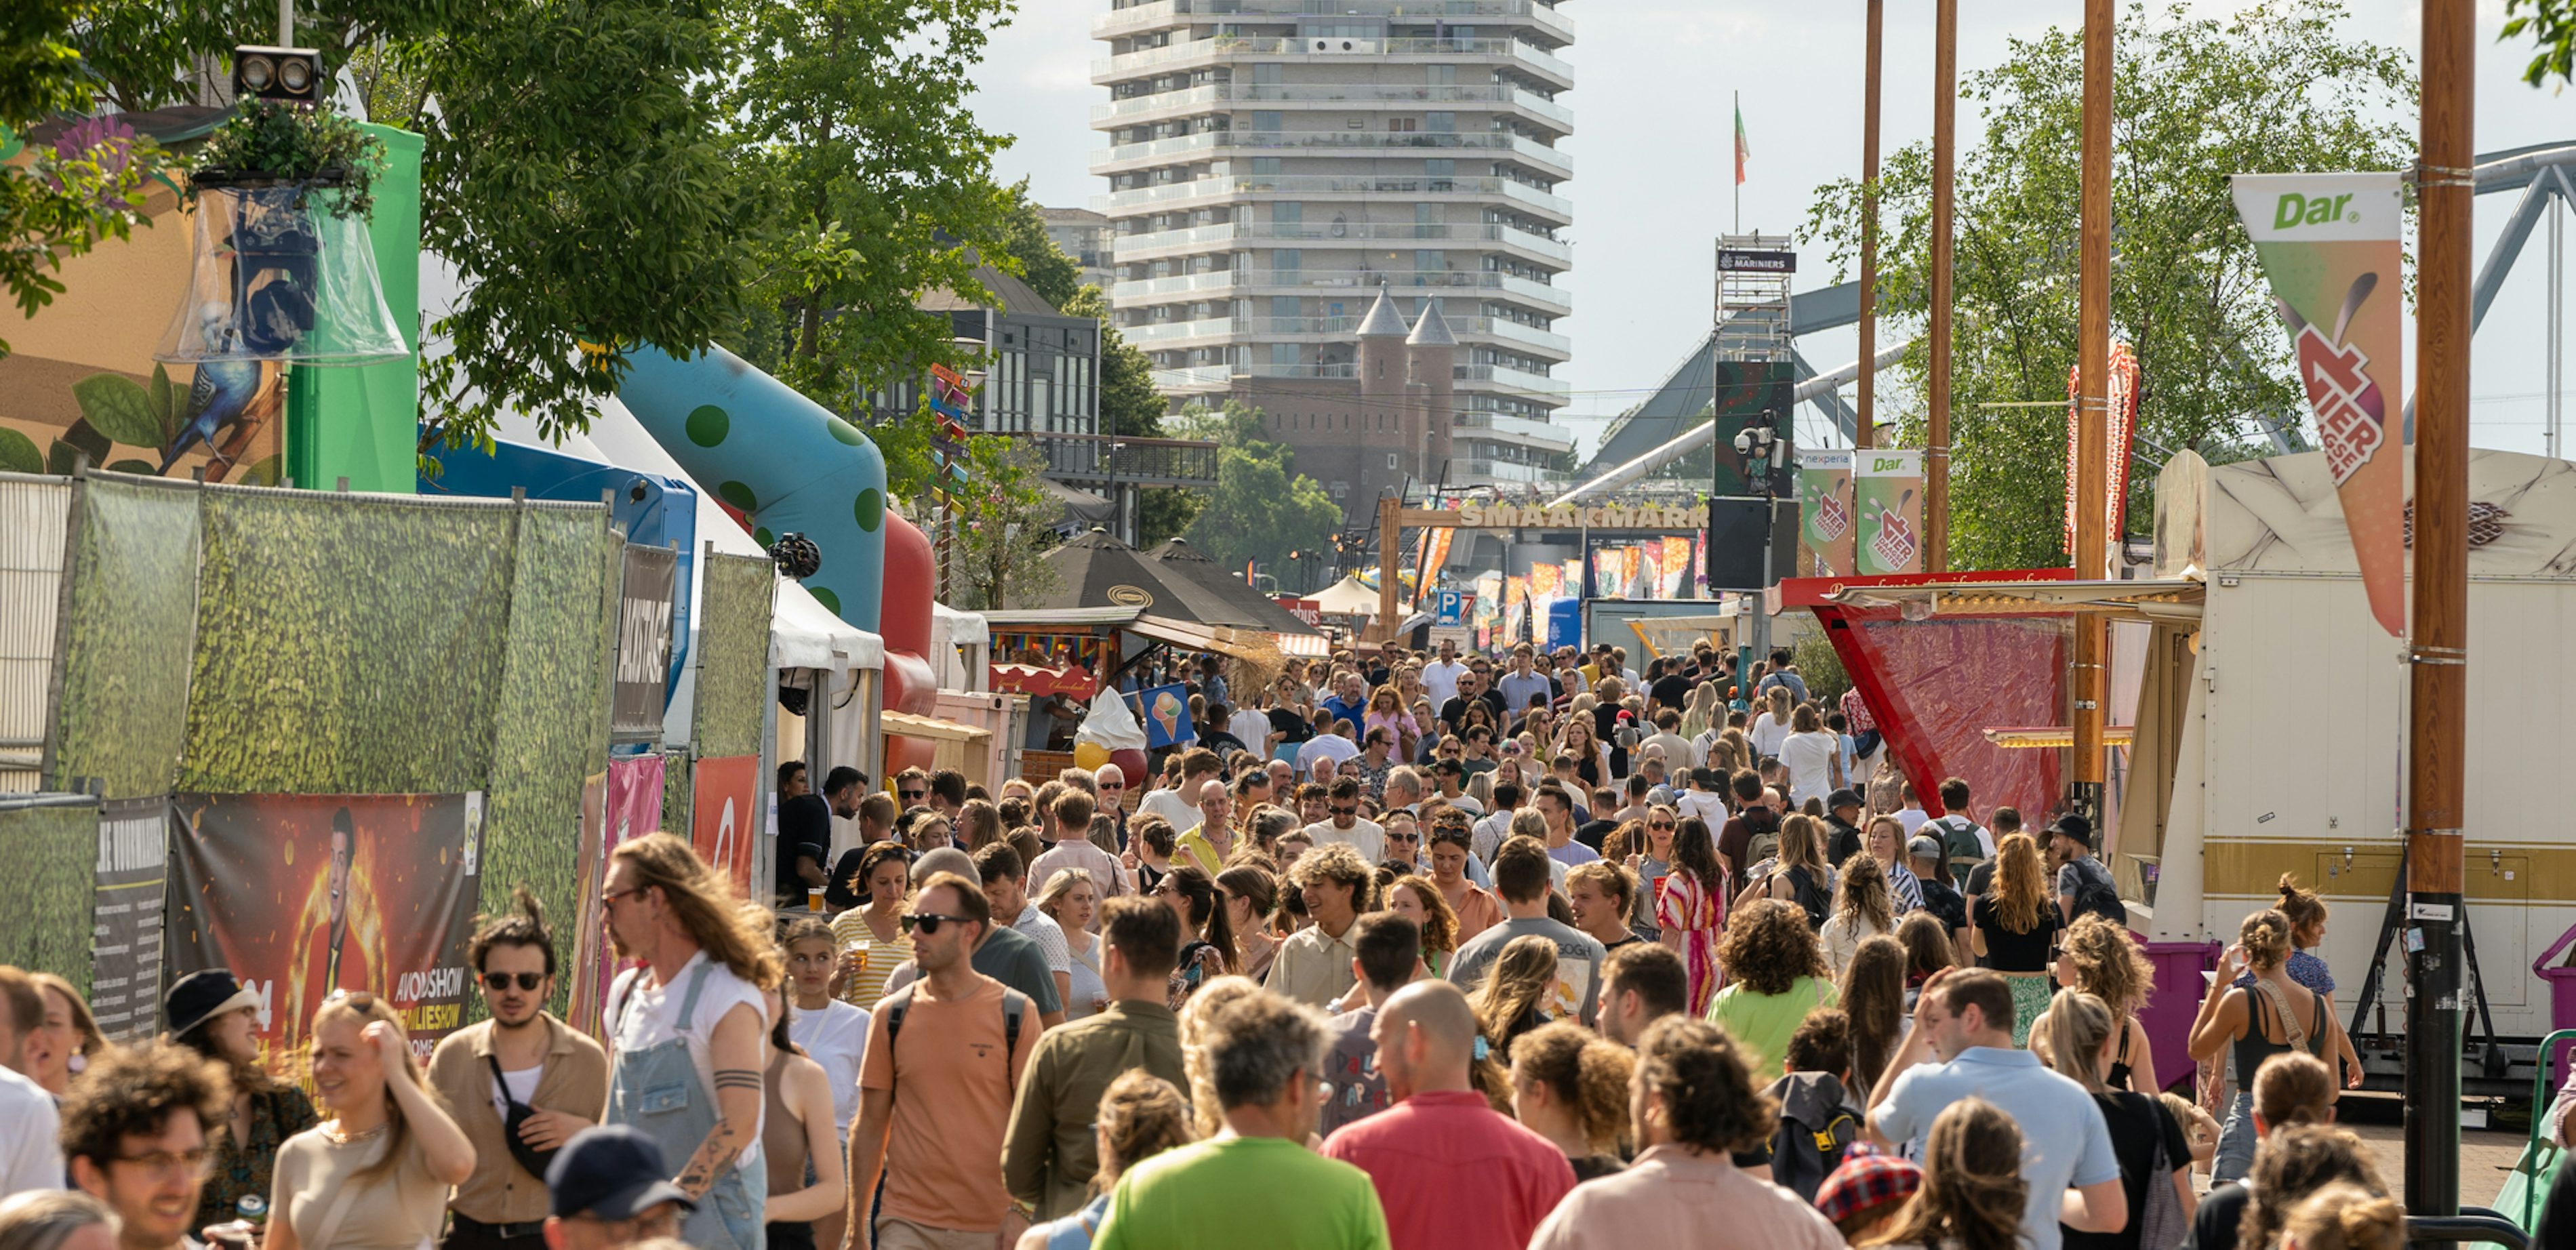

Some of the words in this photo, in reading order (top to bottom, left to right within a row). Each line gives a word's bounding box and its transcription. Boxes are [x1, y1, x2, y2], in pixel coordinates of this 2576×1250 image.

[2273, 193, 2354, 230] Dar
[1734, 260, 1785, 268] MARINIERS
[1805, 455, 1849, 465] nexperia
[1872, 458, 1903, 472] Dar
[1460, 506, 1709, 527] SMAAKMARK
[1874, 542, 1901, 569] FEESTEN
[1878, 538, 1906, 564] DAAGSE
[1443, 593, 1456, 611] P
